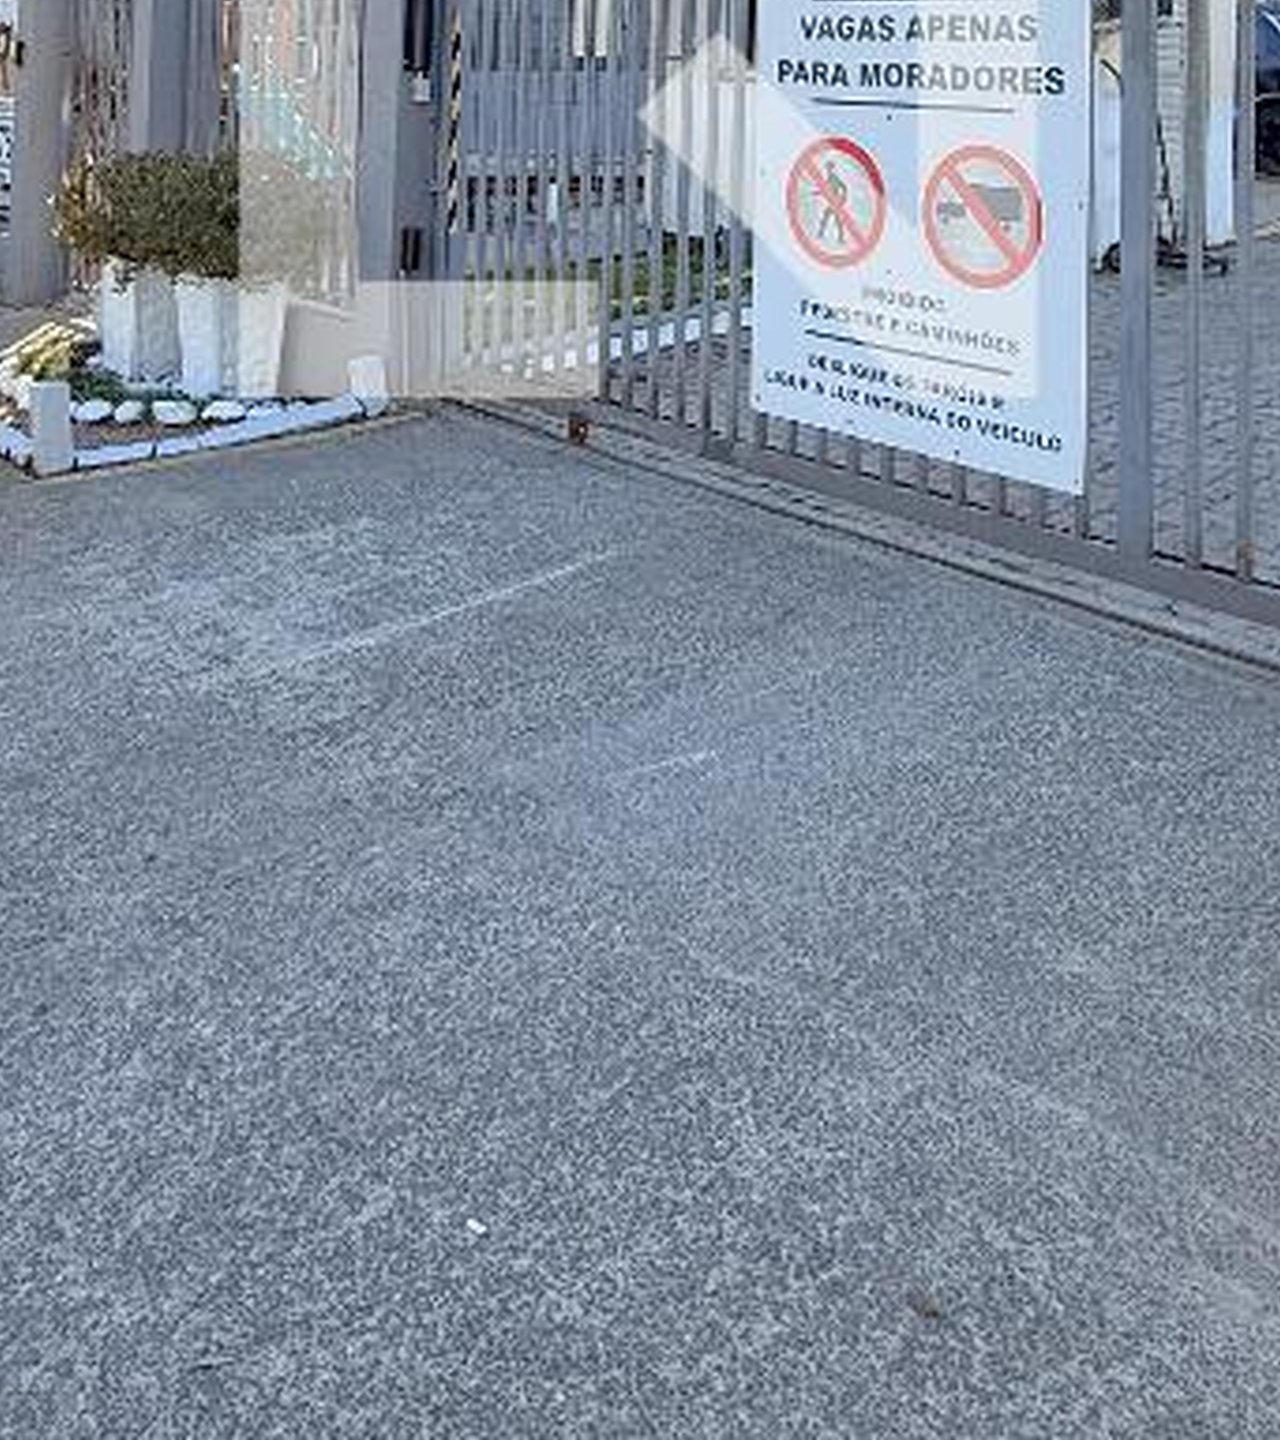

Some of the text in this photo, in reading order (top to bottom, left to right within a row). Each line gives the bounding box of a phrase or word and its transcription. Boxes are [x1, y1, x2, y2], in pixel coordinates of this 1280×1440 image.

[800, 14, 1038, 43] VAGAS APENAS
[777, 59, 1065, 96] PARA MORADORES
